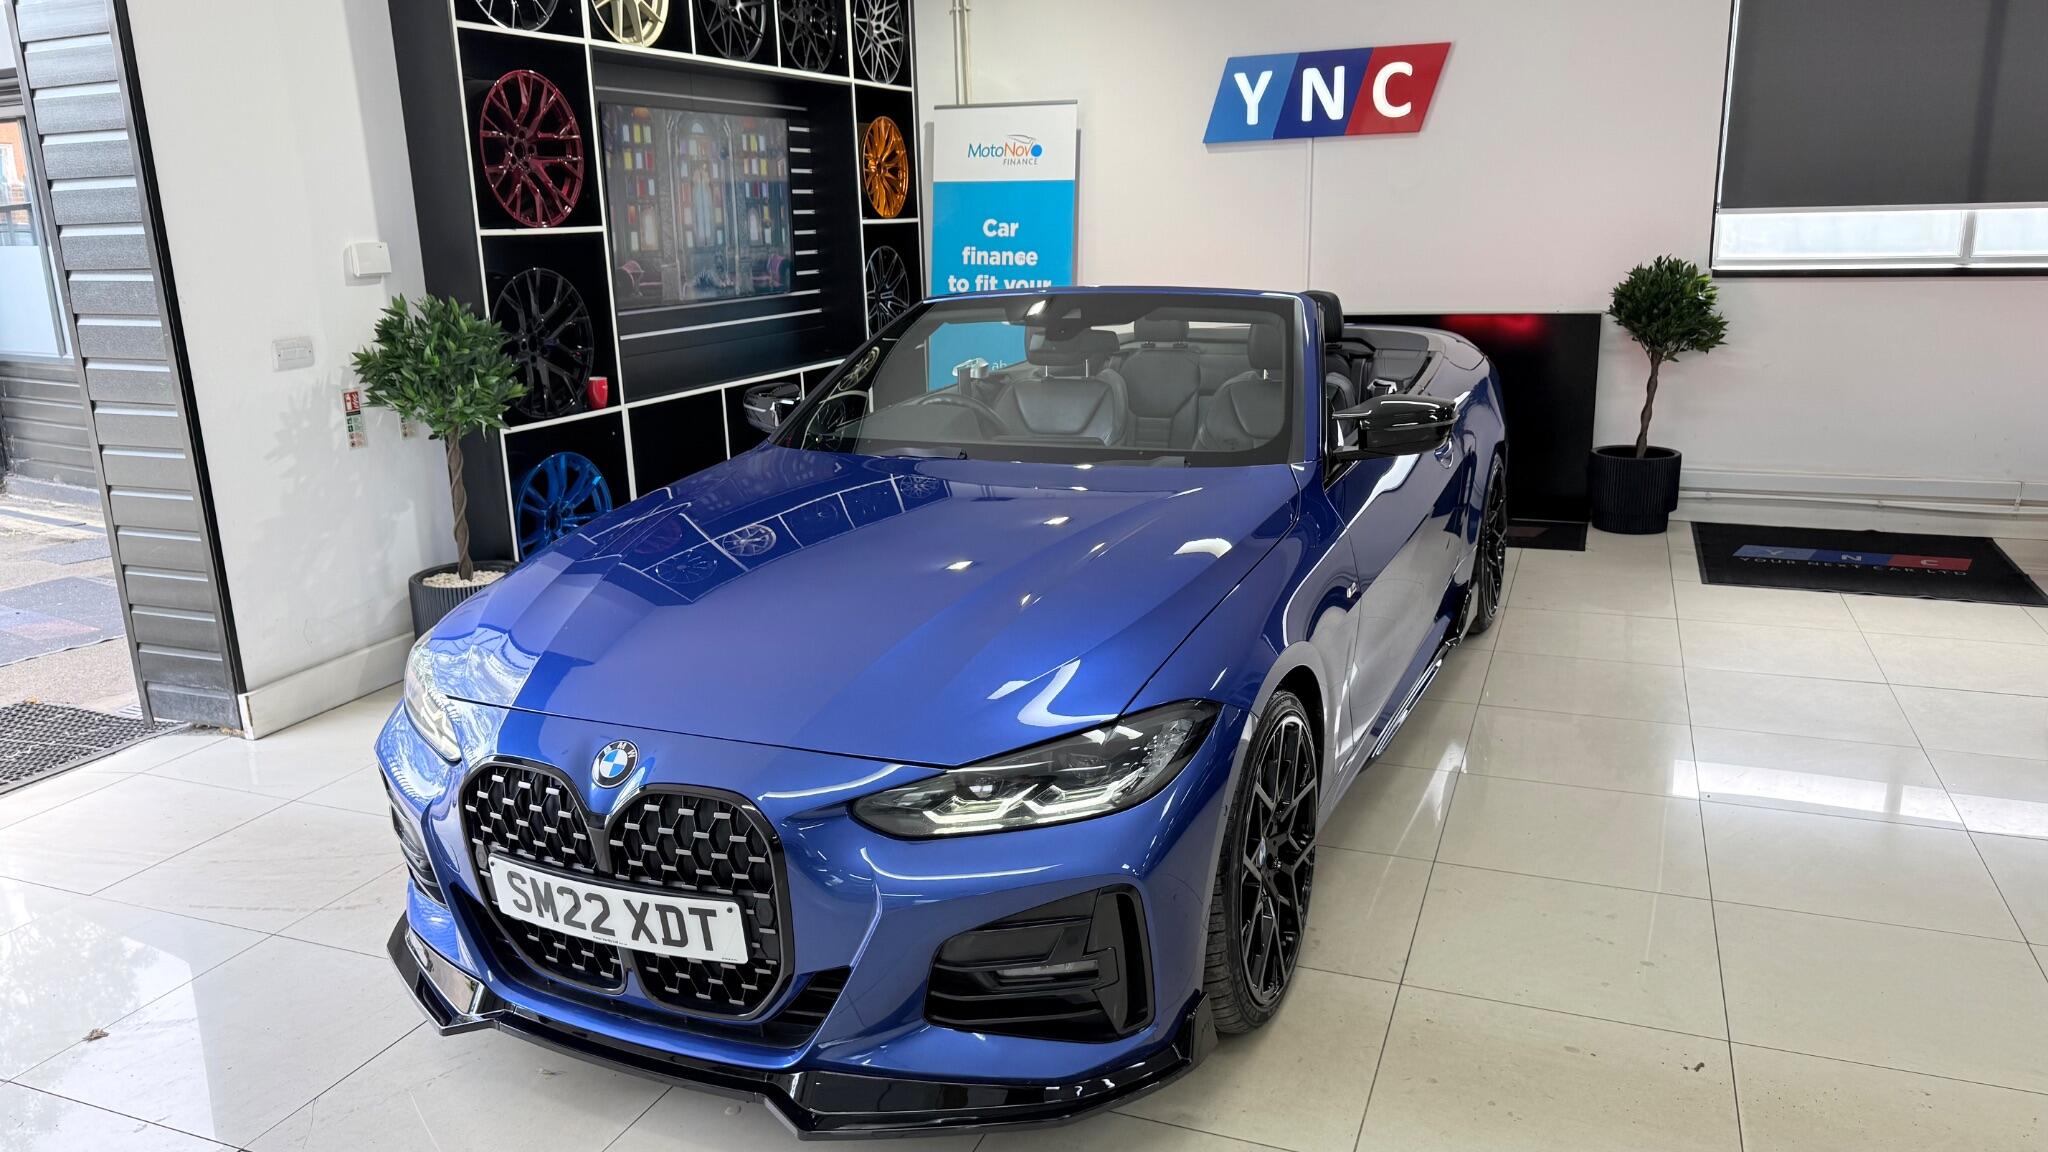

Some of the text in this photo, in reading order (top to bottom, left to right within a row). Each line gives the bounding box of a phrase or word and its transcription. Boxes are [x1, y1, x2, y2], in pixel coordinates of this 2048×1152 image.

[1233, 61, 1413, 126] YNC
[967, 142, 1043, 158] MotoNovo
[982, 218, 1019, 237] Car
[962, 246, 1038, 266] finance
[948, 274, 970, 292] to
[975, 274, 998, 291] fit
[506, 870, 717, 951] SM22 XDT
